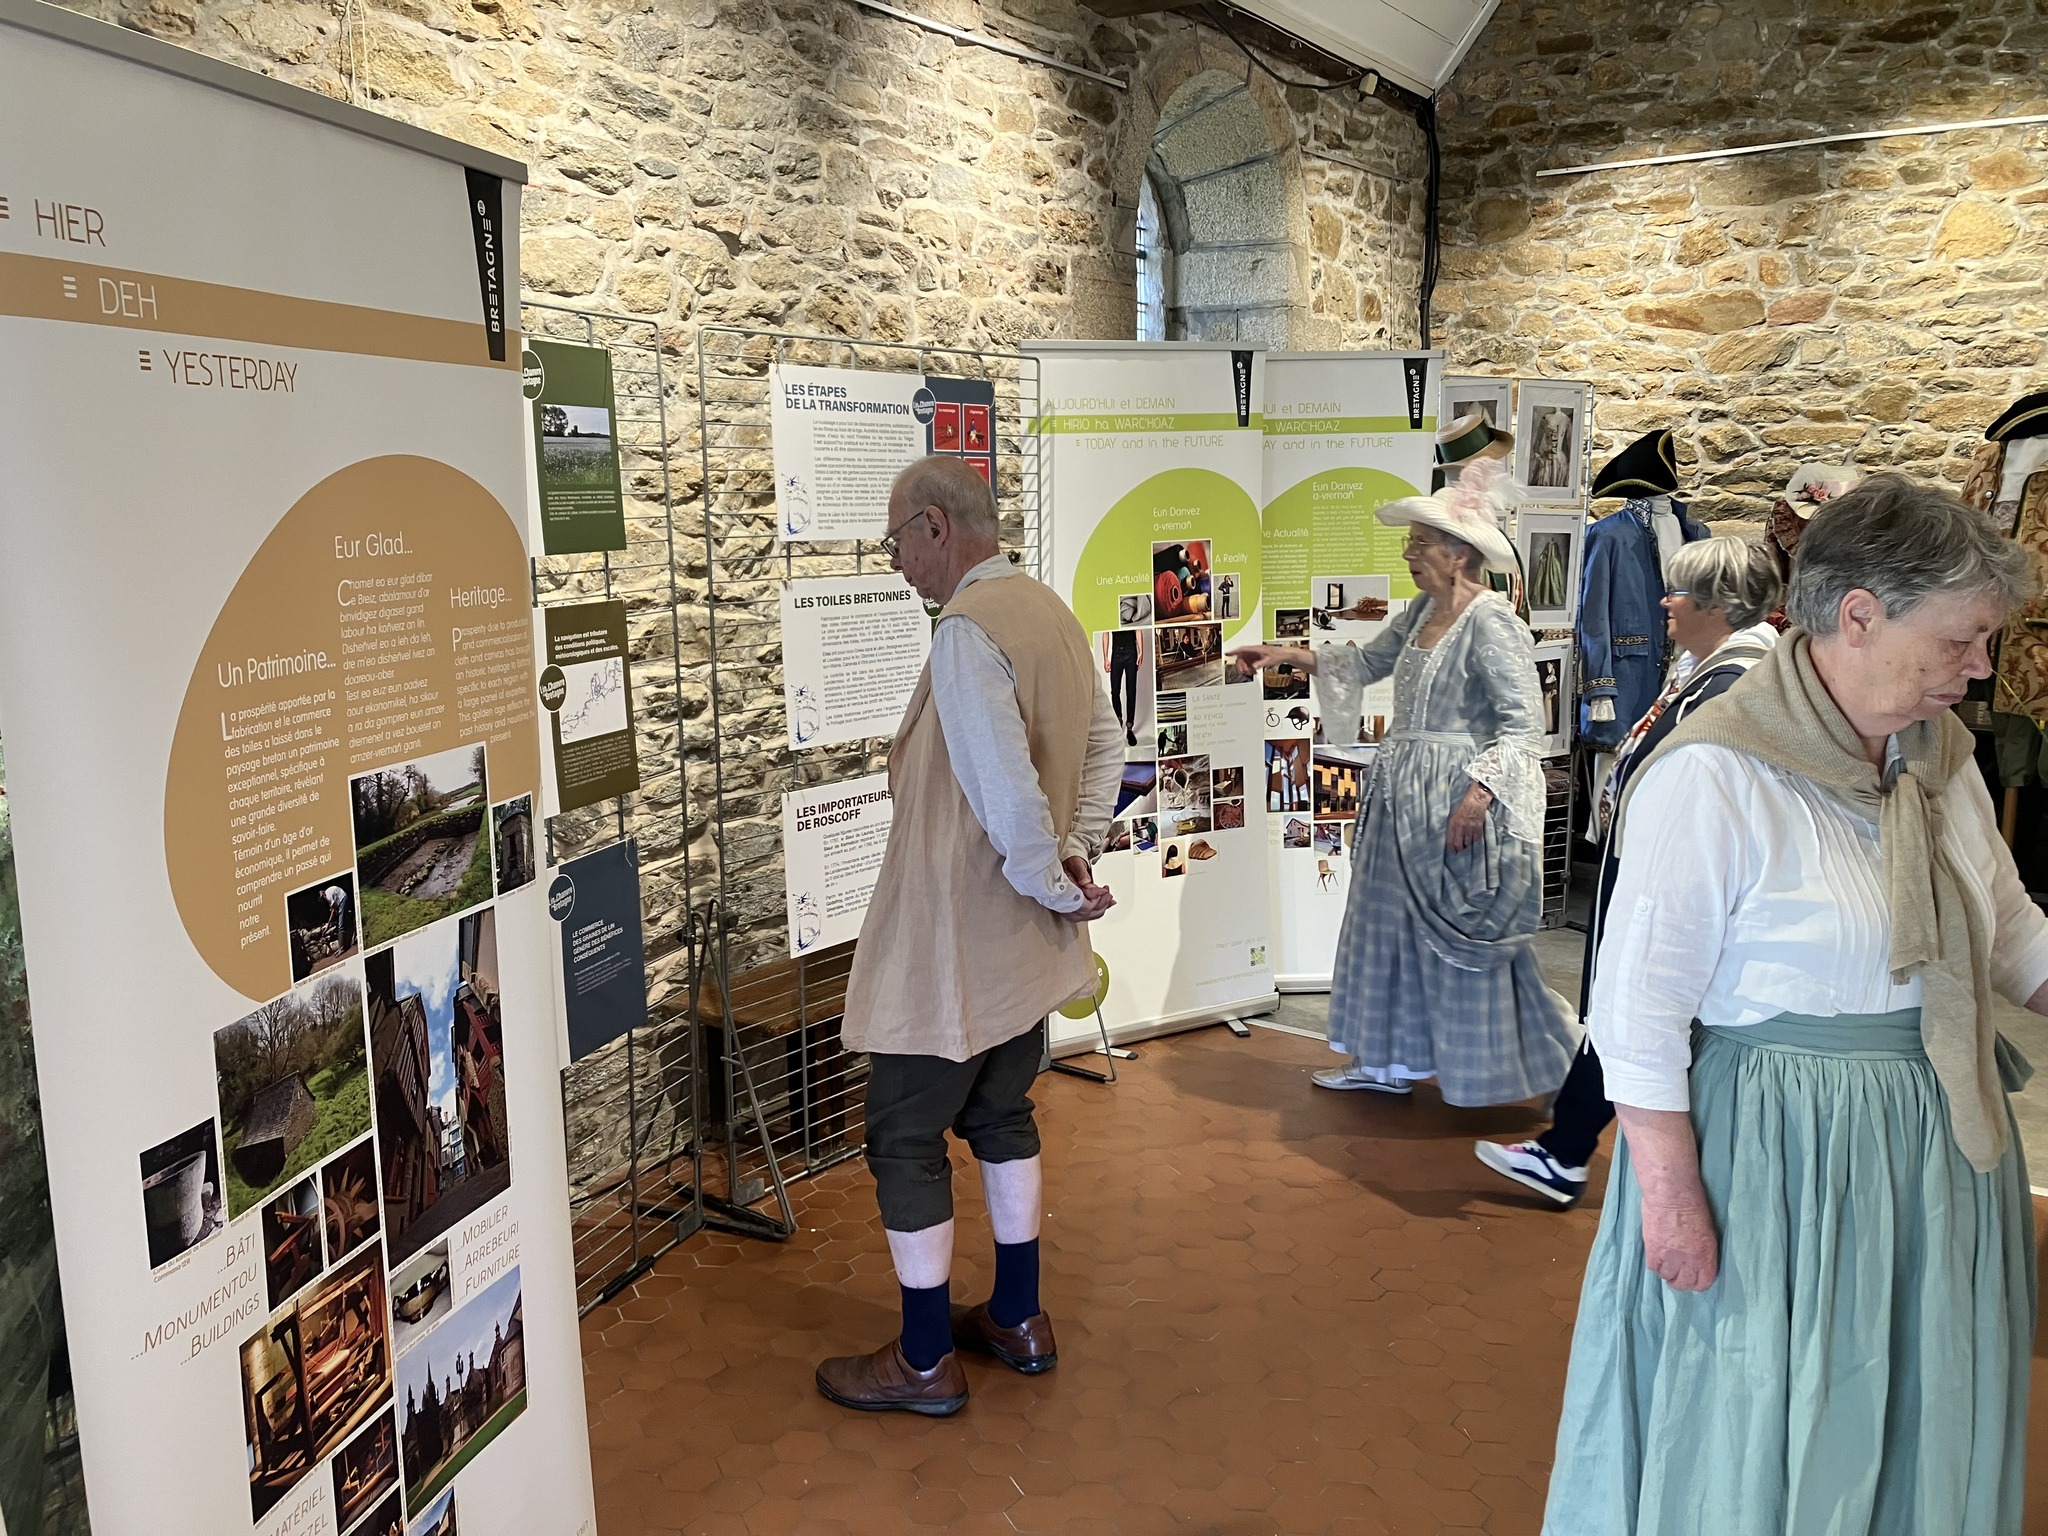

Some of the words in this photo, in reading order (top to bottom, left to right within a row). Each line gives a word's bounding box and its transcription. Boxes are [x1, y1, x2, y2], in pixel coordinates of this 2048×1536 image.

[34, 199, 106, 247] HIER
[482, 218, 501, 333] BRETAGNE
[98, 277, 158, 320] DEH
[163, 349, 298, 393] YESTERDAY
[785, 383, 805, 396] LES
[807, 382, 847, 398] ÉTAPES
[1239, 368, 1247, 416] BRETAGNE
[1412, 375, 1420, 419] BRETAGNE
[786, 398, 800, 410] DE
[802, 398, 817, 410] LA
[818, 399, 910, 416] TRANSFORMATION
[1045, 398, 1116, 410] AUJOURD'HUI
[1120, 399, 1131, 410] et
[1136, 397, 1176, 409] DEMAIN
[1282, 403, 1293, 414] et
[1298, 402, 1341, 414] DEMAIN
[1063, 418, 1090, 430] HIRIO
[1095, 417, 1109, 430] ha
[1114, 417, 1175, 430] WARC'HOAZ
[1275, 420, 1340, 432] WARC'HOAZ
[1085, 437, 1117, 450] TODAY
[1122, 437, 1144, 449] and
[1148, 437, 1157, 448] in
[1163, 436, 1179, 448] the
[1184, 435, 1224, 447] FUTURE
[1283, 439, 1305, 450] and
[1311, 439, 1321, 449] in
[1327, 438, 1345, 449] the
[1351, 437, 1394, 448] FUTURE
[1312, 481, 1328, 491] Eun
[1331, 480, 1363, 490] Danvez
[1153, 507, 1168, 518] Eun
[1170, 506, 1201, 517] Danvez
[1273, 528, 1309, 538] Actualité
[335, 536, 360, 559] Eur
[366, 531, 413, 556] Glad...
[1215, 553, 1221, 563] A
[1223, 552, 1248, 565] Reality
[375, 578, 385, 587] eo
[387, 577, 398, 585] eur
[1096, 575, 1112, 586] Une
[1115, 573, 1150, 584] Actualité
[450, 586, 512, 608] Heritage...
[794, 597, 814, 609] LES
[815, 594, 852, 607] TOILES
[854, 589, 911, 605] BRETONNES
[406, 602, 423, 616] gand
[217, 661, 244, 688] Un
[247, 649, 336, 683] Patrimoine...
[346, 688, 359, 700] Test
[360, 689, 370, 698] eo
[372, 686, 385, 696] euz
[388, 684, 401, 693] eun
[238, 702, 276, 723] prospérité
[278, 695, 311, 712] apportée
[314, 692, 326, 705] par
[327, 689, 335, 700] la
[232, 721, 272, 738] fabrication
[274, 716, 281, 728] et
[283, 715, 290, 726] le
[292, 707, 331, 724] commerce
[364, 718, 374, 729] da
[376, 713, 408, 729] gompren
[410, 710, 423, 720] eun
[225, 747, 240, 758] des
[242, 741, 262, 754] toiles
[264, 739, 269, 748] a
[271, 731, 292, 746] laissé
[294, 728, 313, 740] dans
[314, 724, 321, 735] le
[226, 758, 261, 776] paysage
[262, 751, 285, 765] breton
[288, 748, 297, 758] un
[300, 737, 339, 757] patrimoine
[228, 768, 278, 792] exceptionnel,
[280, 759, 317, 778] spécifique
[320, 755, 324, 766] à
[229, 794, 259, 810] chaque
[260, 784, 292, 800] territoire,
[294, 771, 323, 790] révélant
[230, 815, 246, 827] une
[248, 805, 275, 824] grande
[276, 793, 306, 812] diversité
[308, 791, 319, 802] de
[796, 805, 816, 819] LES
[818, 790, 892, 815] IMPORTATEURS
[797, 820, 812, 832] DE
[813, 808, 861, 829] ROSCOFF
[232, 823, 276, 844] savoir-faire.
[233, 844, 262, 862] Témoin
[264, 838, 280, 851] d'un
[282, 832, 297, 845] âge
[298, 826, 313, 839] d'or
[235, 854, 284, 878] économique,
[285, 848, 290, 860] il
[291, 838, 318, 860] permet
[320, 836, 329, 847] de
[236, 871, 282, 895] comprendre
[284, 866, 294, 877] un
[295, 855, 317, 875] passé
[319, 849, 331, 866] qui
[238, 893, 262, 912] nourrit
[240, 914, 259, 929] notre
[578, 919, 603, 935] COMMERCE
[240, 924, 271, 948] présent.
[572, 938, 581, 946] DES
